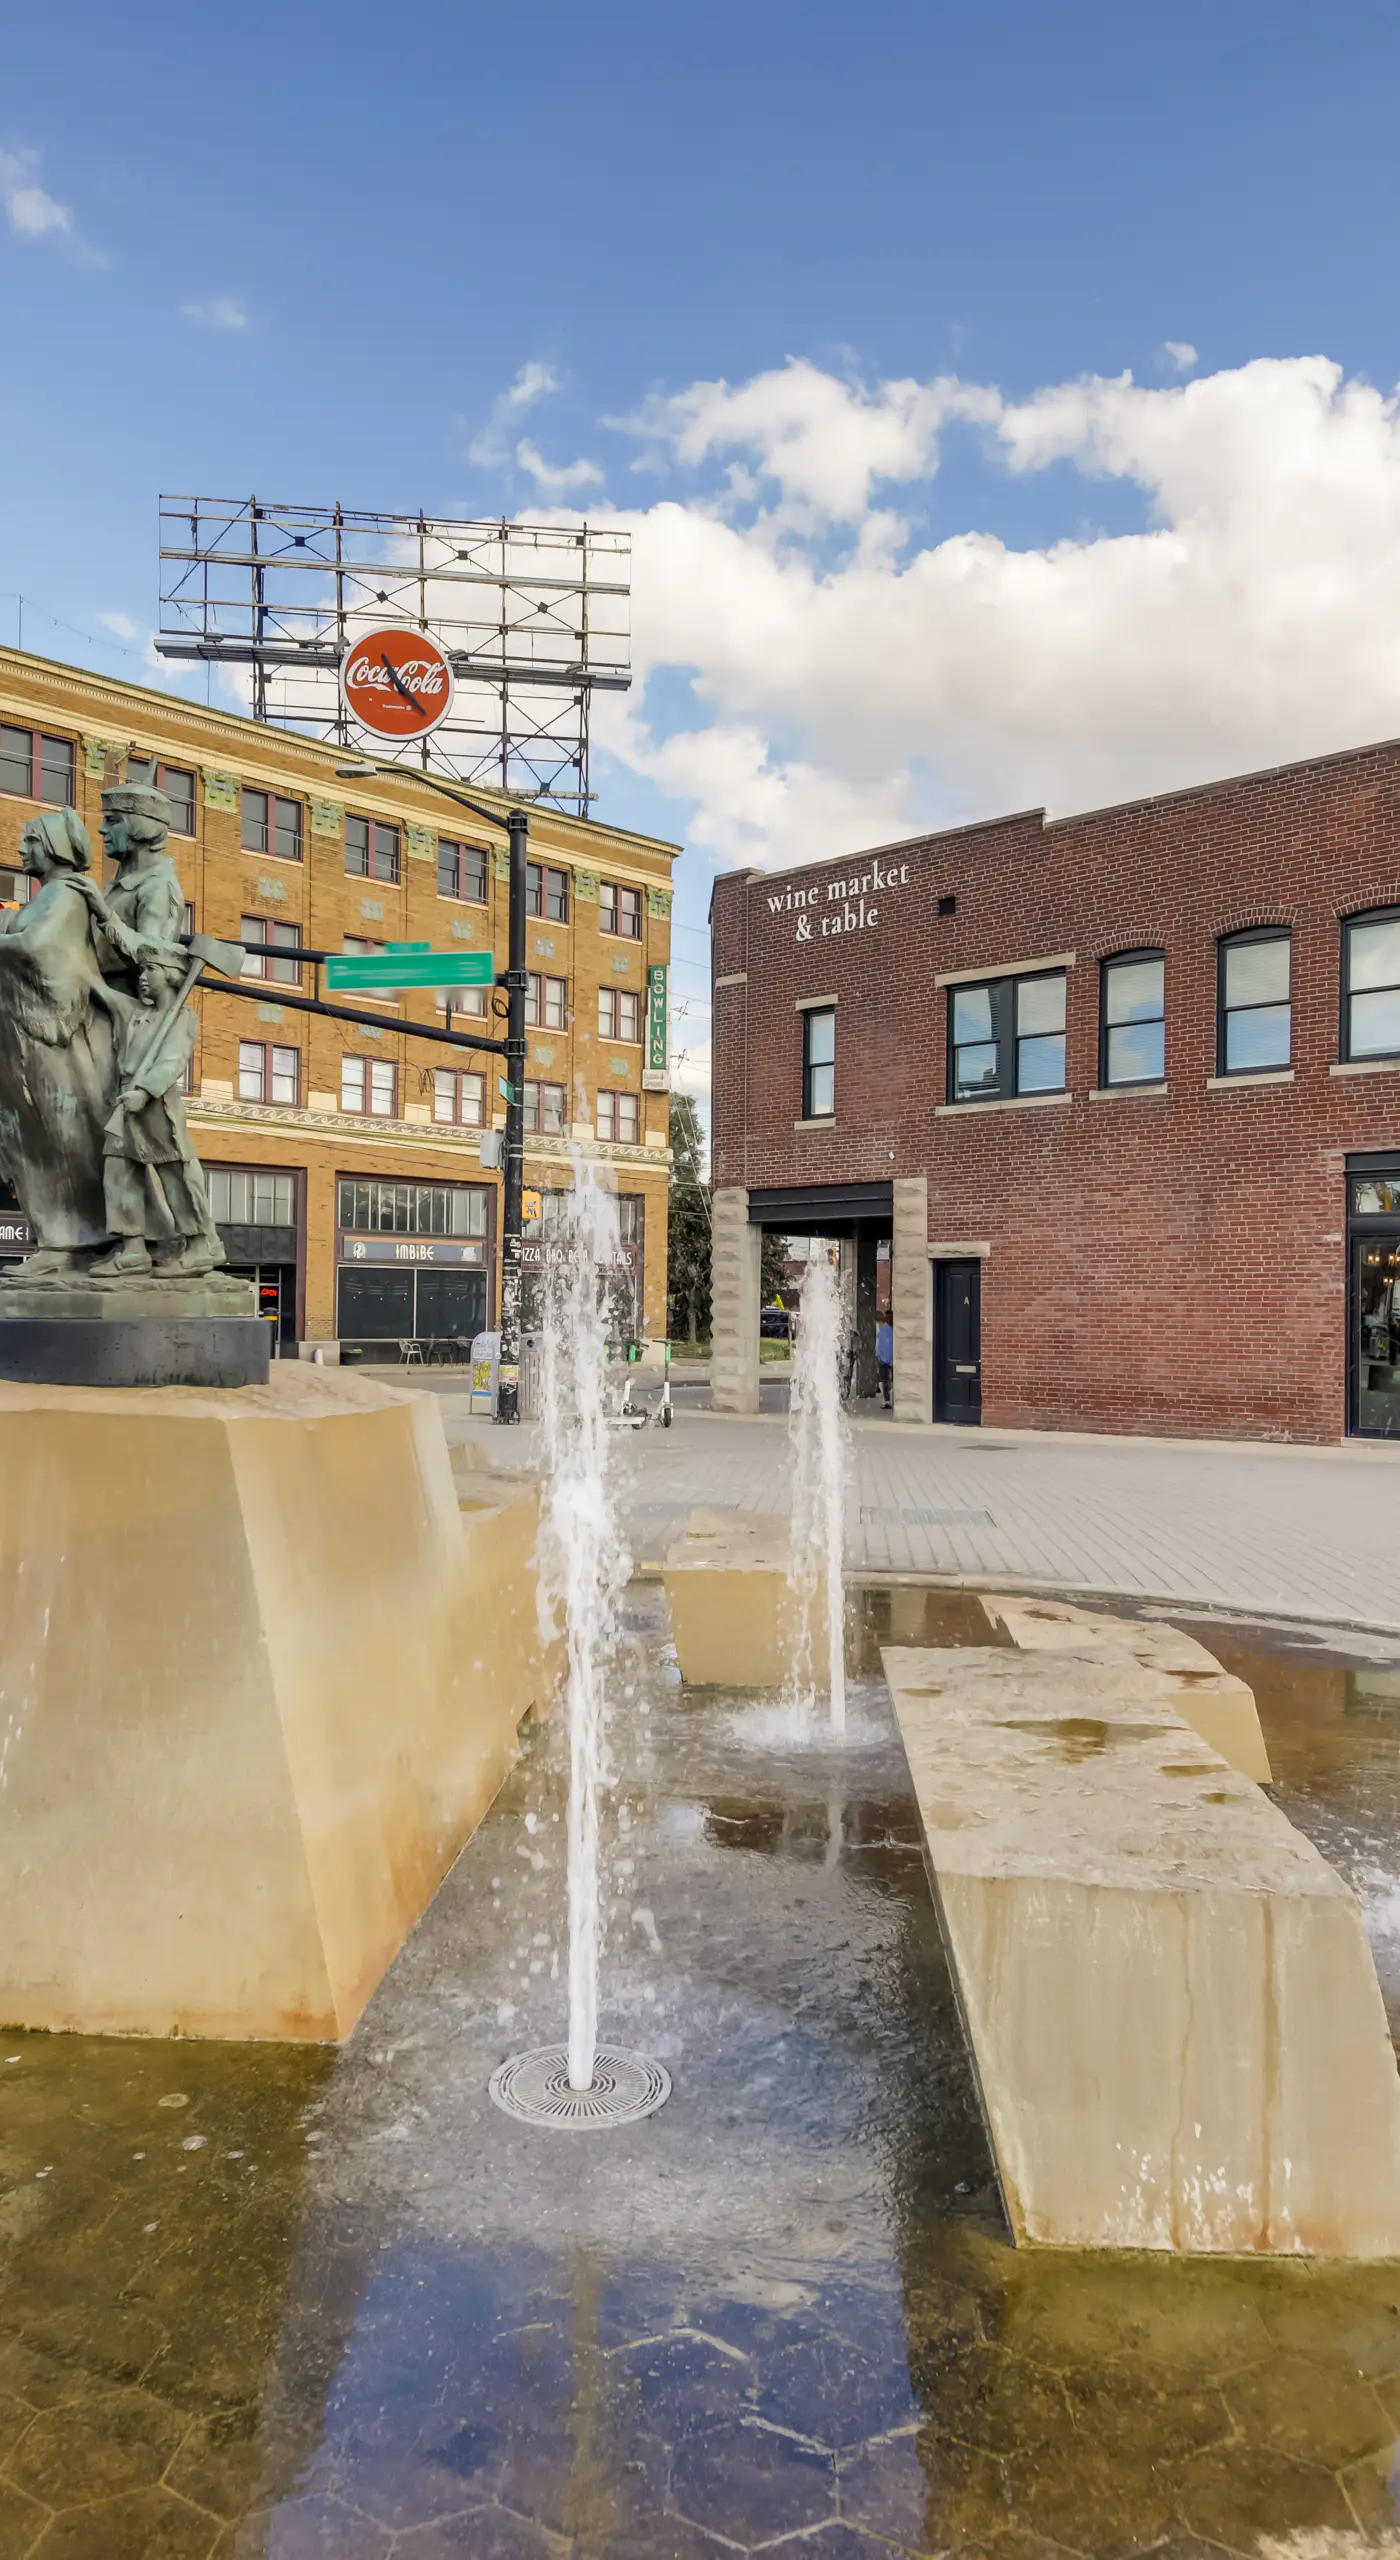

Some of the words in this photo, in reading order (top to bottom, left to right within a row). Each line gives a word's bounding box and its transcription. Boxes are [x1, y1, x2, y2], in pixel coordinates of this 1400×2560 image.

[767, 885, 819, 913] wine
[827, 860, 910, 900] market
[795, 914, 814, 942] &
[821, 899, 879, 937] table
[652, 970, 664, 1065] BOWLING
[521, 1247, 541, 1262] IZZA
[568, 1249, 588, 1263] BER
[963, 1296, 970, 1305] A
